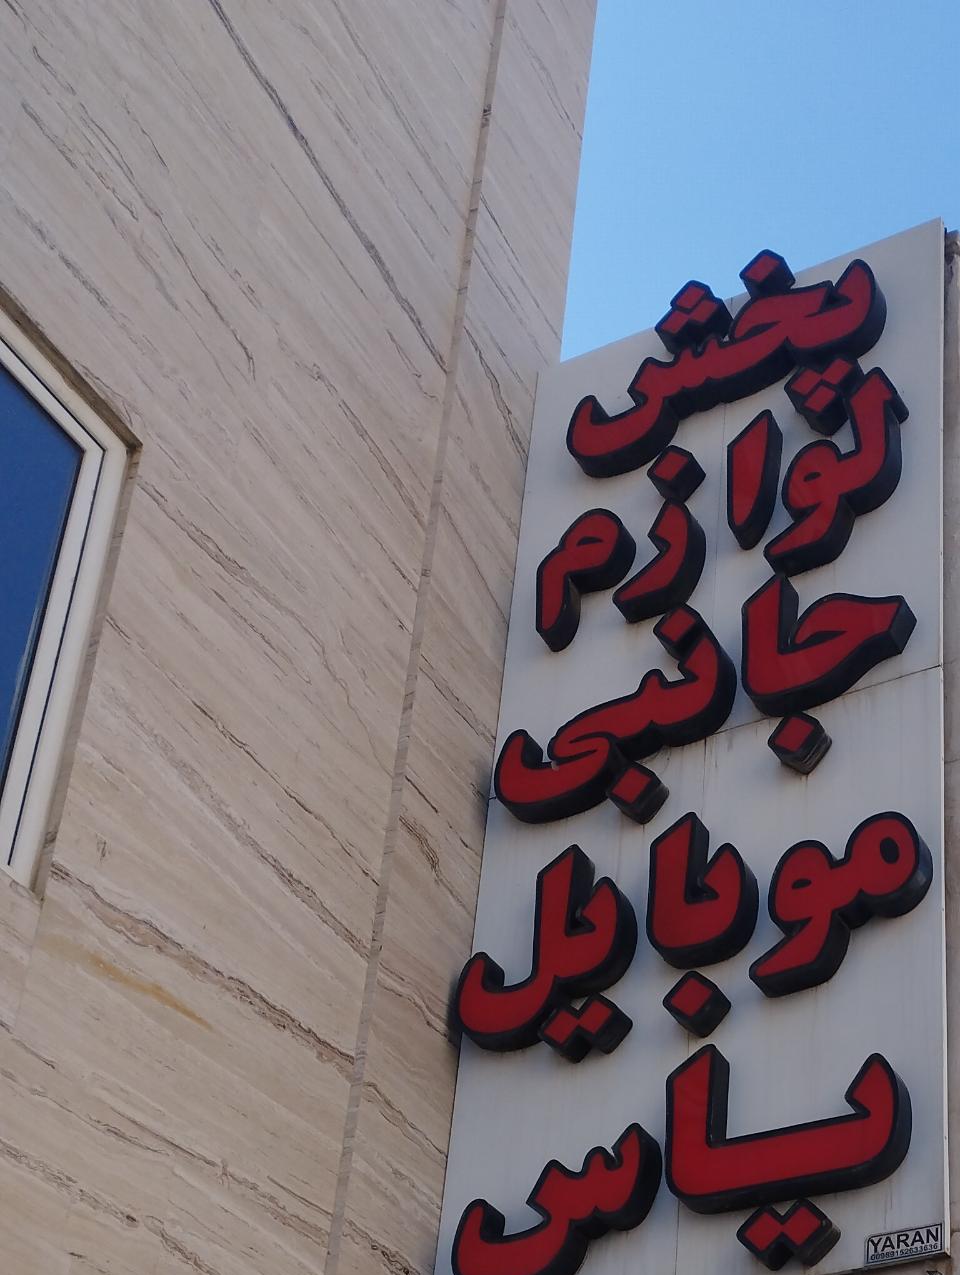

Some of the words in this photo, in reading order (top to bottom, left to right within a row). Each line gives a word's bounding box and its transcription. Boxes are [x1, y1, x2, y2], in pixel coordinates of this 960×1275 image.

[566, 249, 887, 477] پخش
[536, 367, 909, 652] لوازم
[494, 575, 917, 824] جانبی
[450, 811, 933, 1063] موبایل
[869, 1227, 939, 1254] YARAN
